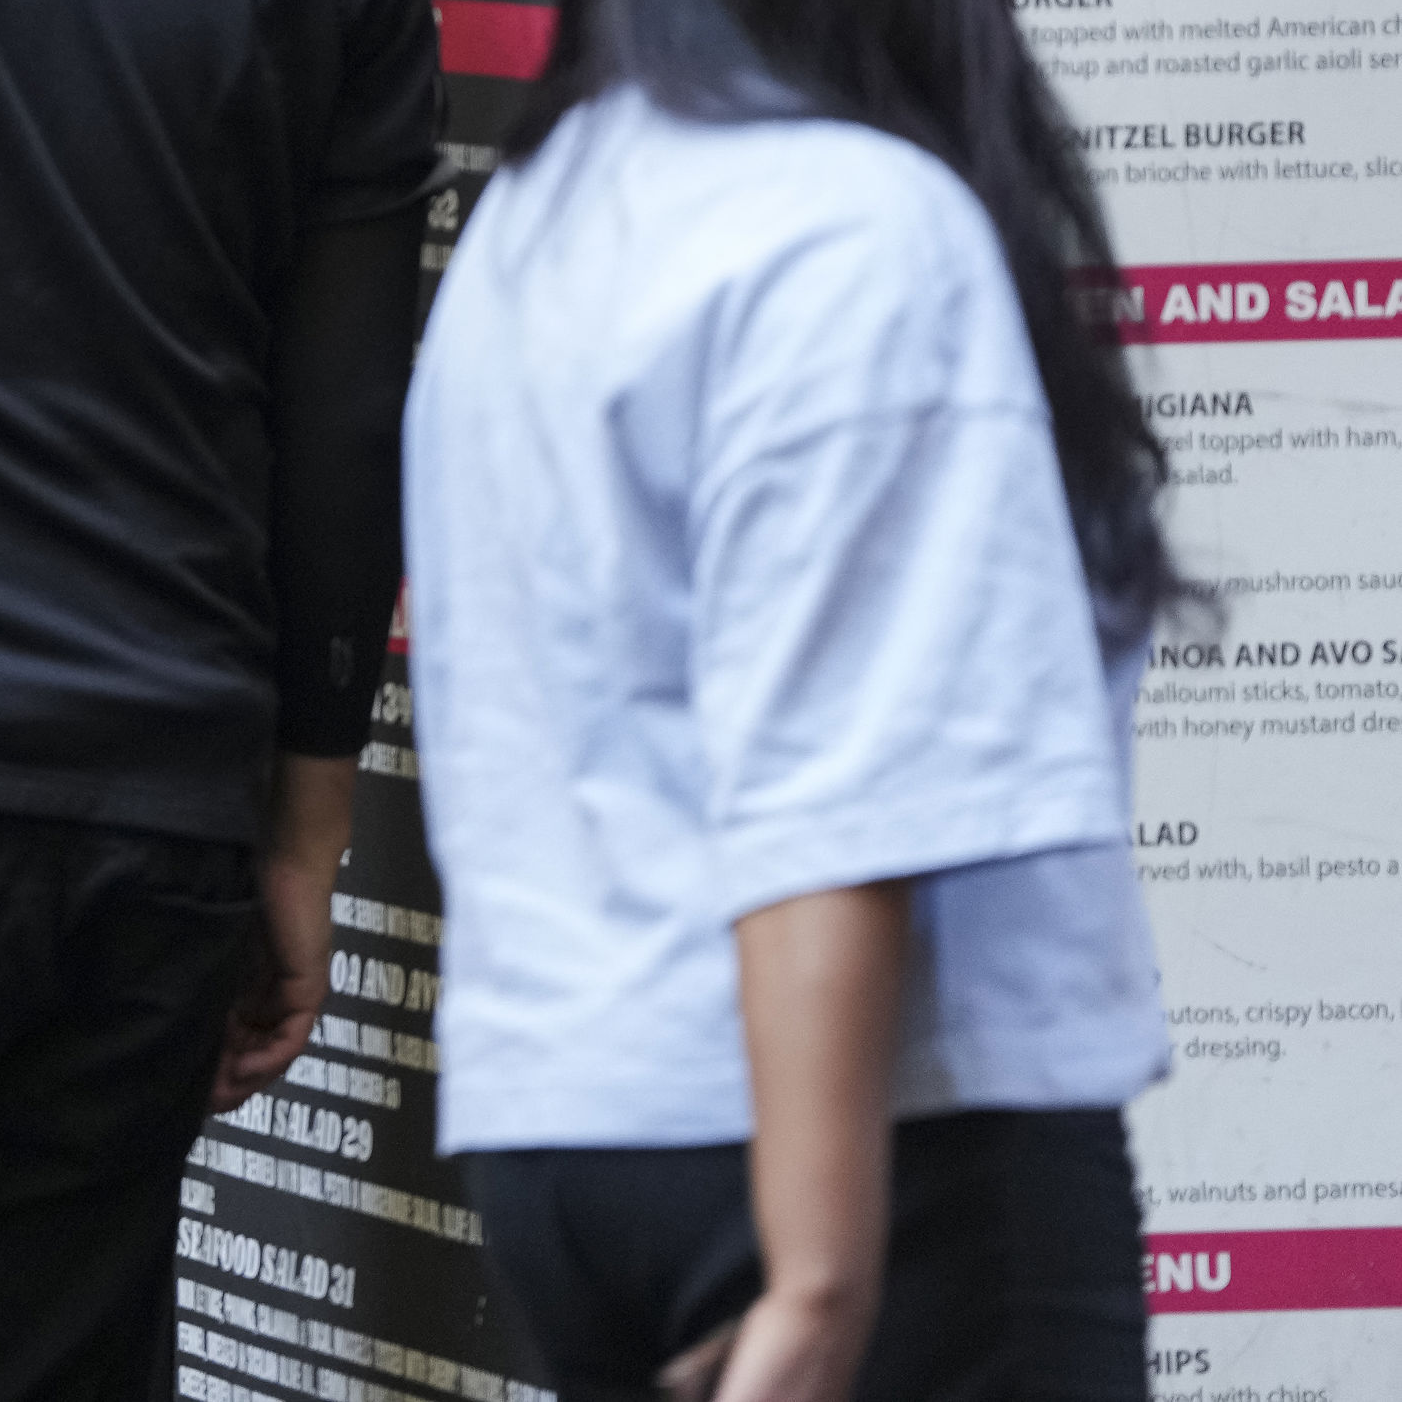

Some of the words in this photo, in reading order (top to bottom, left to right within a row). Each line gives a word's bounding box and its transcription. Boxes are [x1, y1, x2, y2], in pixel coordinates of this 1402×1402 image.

[1125, 20, 1173, 41] with
[1180, 18, 1260, 40] melted
[1268, 17, 1375, 39] American
[1106, 56, 1149, 76] and
[1155, 54, 1241, 74] roasted
[1247, 52, 1309, 78] garlic
[1316, 48, 1362, 71] aioli
[1185, 120, 1305, 149] BURGER
[1125, 160, 1210, 183] brioche
[1220, 160, 1268, 181] with
[1275, 157, 1358, 182] lettuce,
[1160, 283, 1270, 324] AND
[1200, 432, 1282, 454] topped
[1291, 429, 1339, 449] with
[1346, 426, 1402, 448] ham,
[1172, 463, 1238, 485] salad.
[1227, 567, 1351, 593] mushroom
[1150, 643, 1225, 669] NOA
[1234, 642, 1300, 668] AND
[1311, 640, 1373, 666] AVO
[1242, 680, 1311, 704] sticks,
[1182, 714, 1255, 741] honey
[1260, 711, 1356, 734] mustard
[1198, 859, 1252, 882] with,
[1260, 856, 1311, 879] basil
[1316, 857, 1380, 881] pesto
[1246, 1003, 1312, 1027] crispy
[1318, 999, 1395, 1022] bacon,
[1185, 1035, 1286, 1062] dressing.
[1168, 1180, 1258, 1204] walnuts
[1264, 1179, 1307, 1201] and
[177, 1216, 261, 1280] SEAFOOD
[260, 1243, 330, 1302] SALAD
